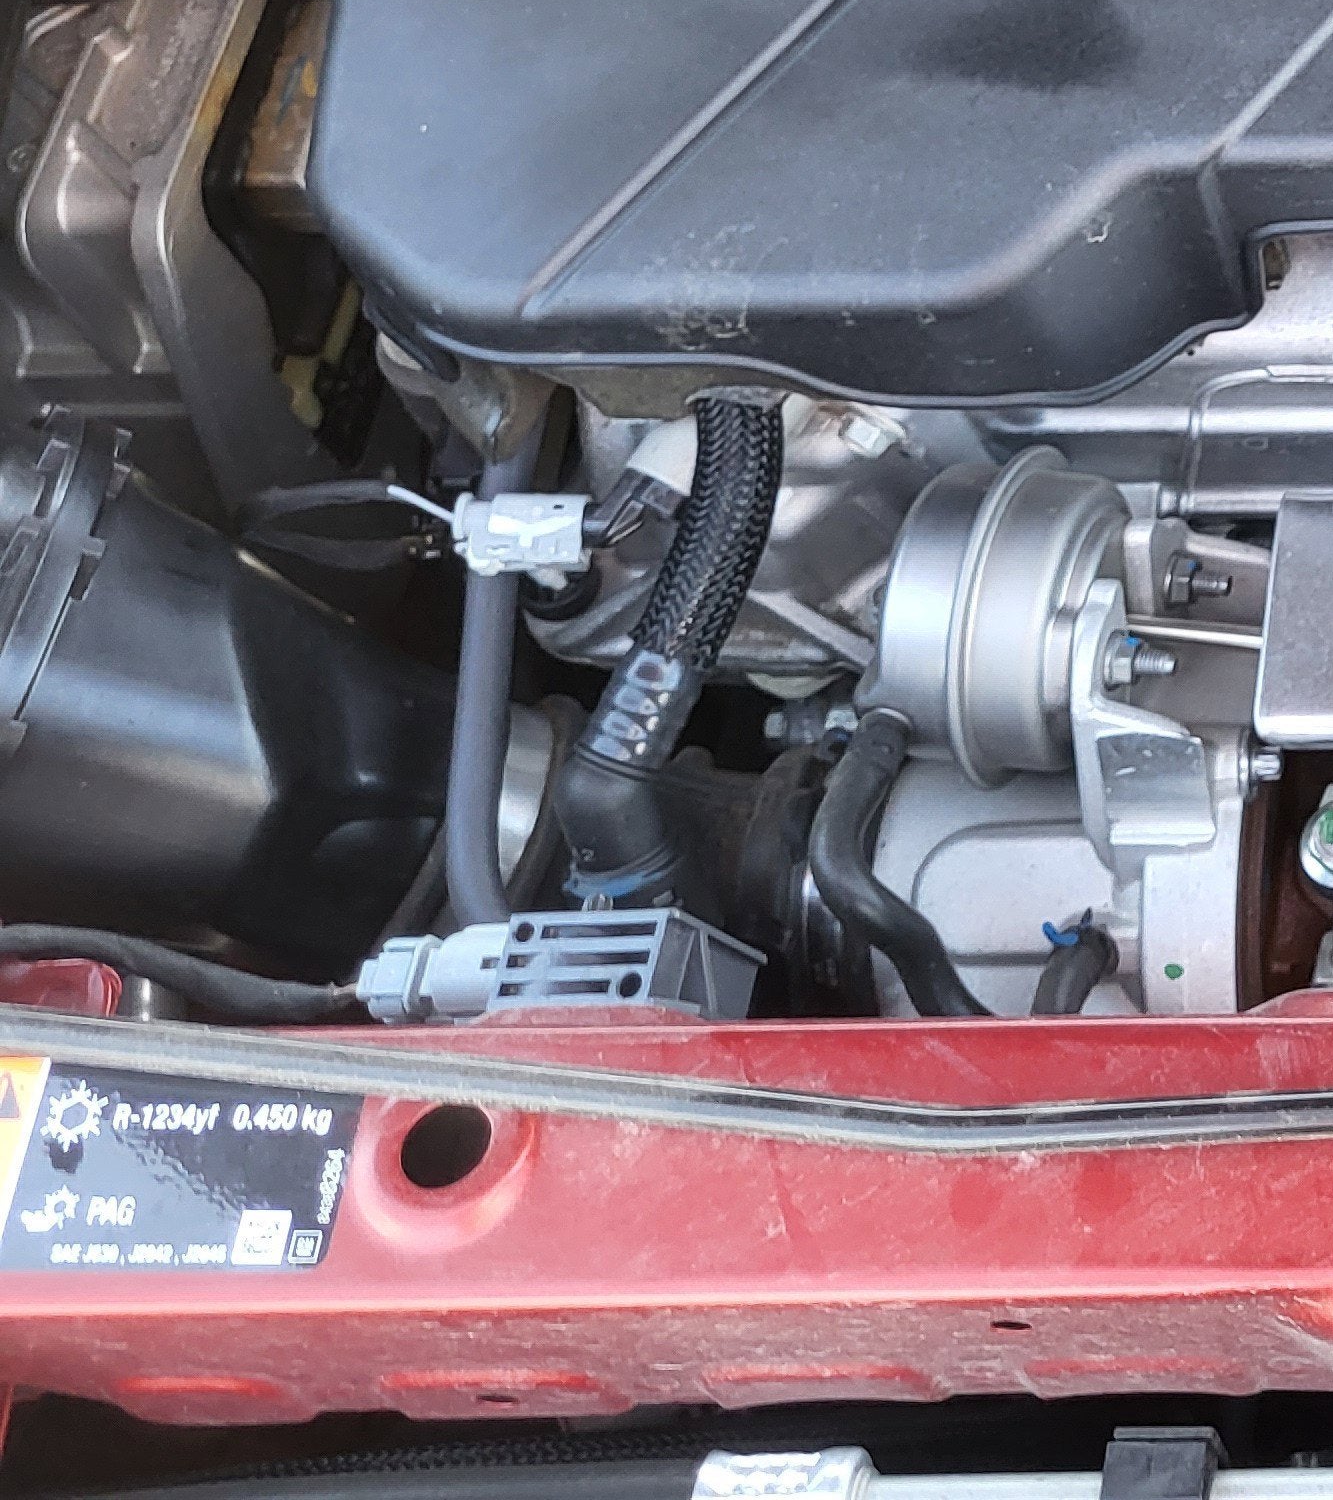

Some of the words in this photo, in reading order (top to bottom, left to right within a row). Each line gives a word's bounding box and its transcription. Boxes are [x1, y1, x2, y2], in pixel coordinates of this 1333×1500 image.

[112, 1102, 221, 1136] R-1234yf
[231, 1103, 298, 1132] 0.450
[301, 1103, 333, 1137] kg
[86, 1195, 138, 1227] PAG
